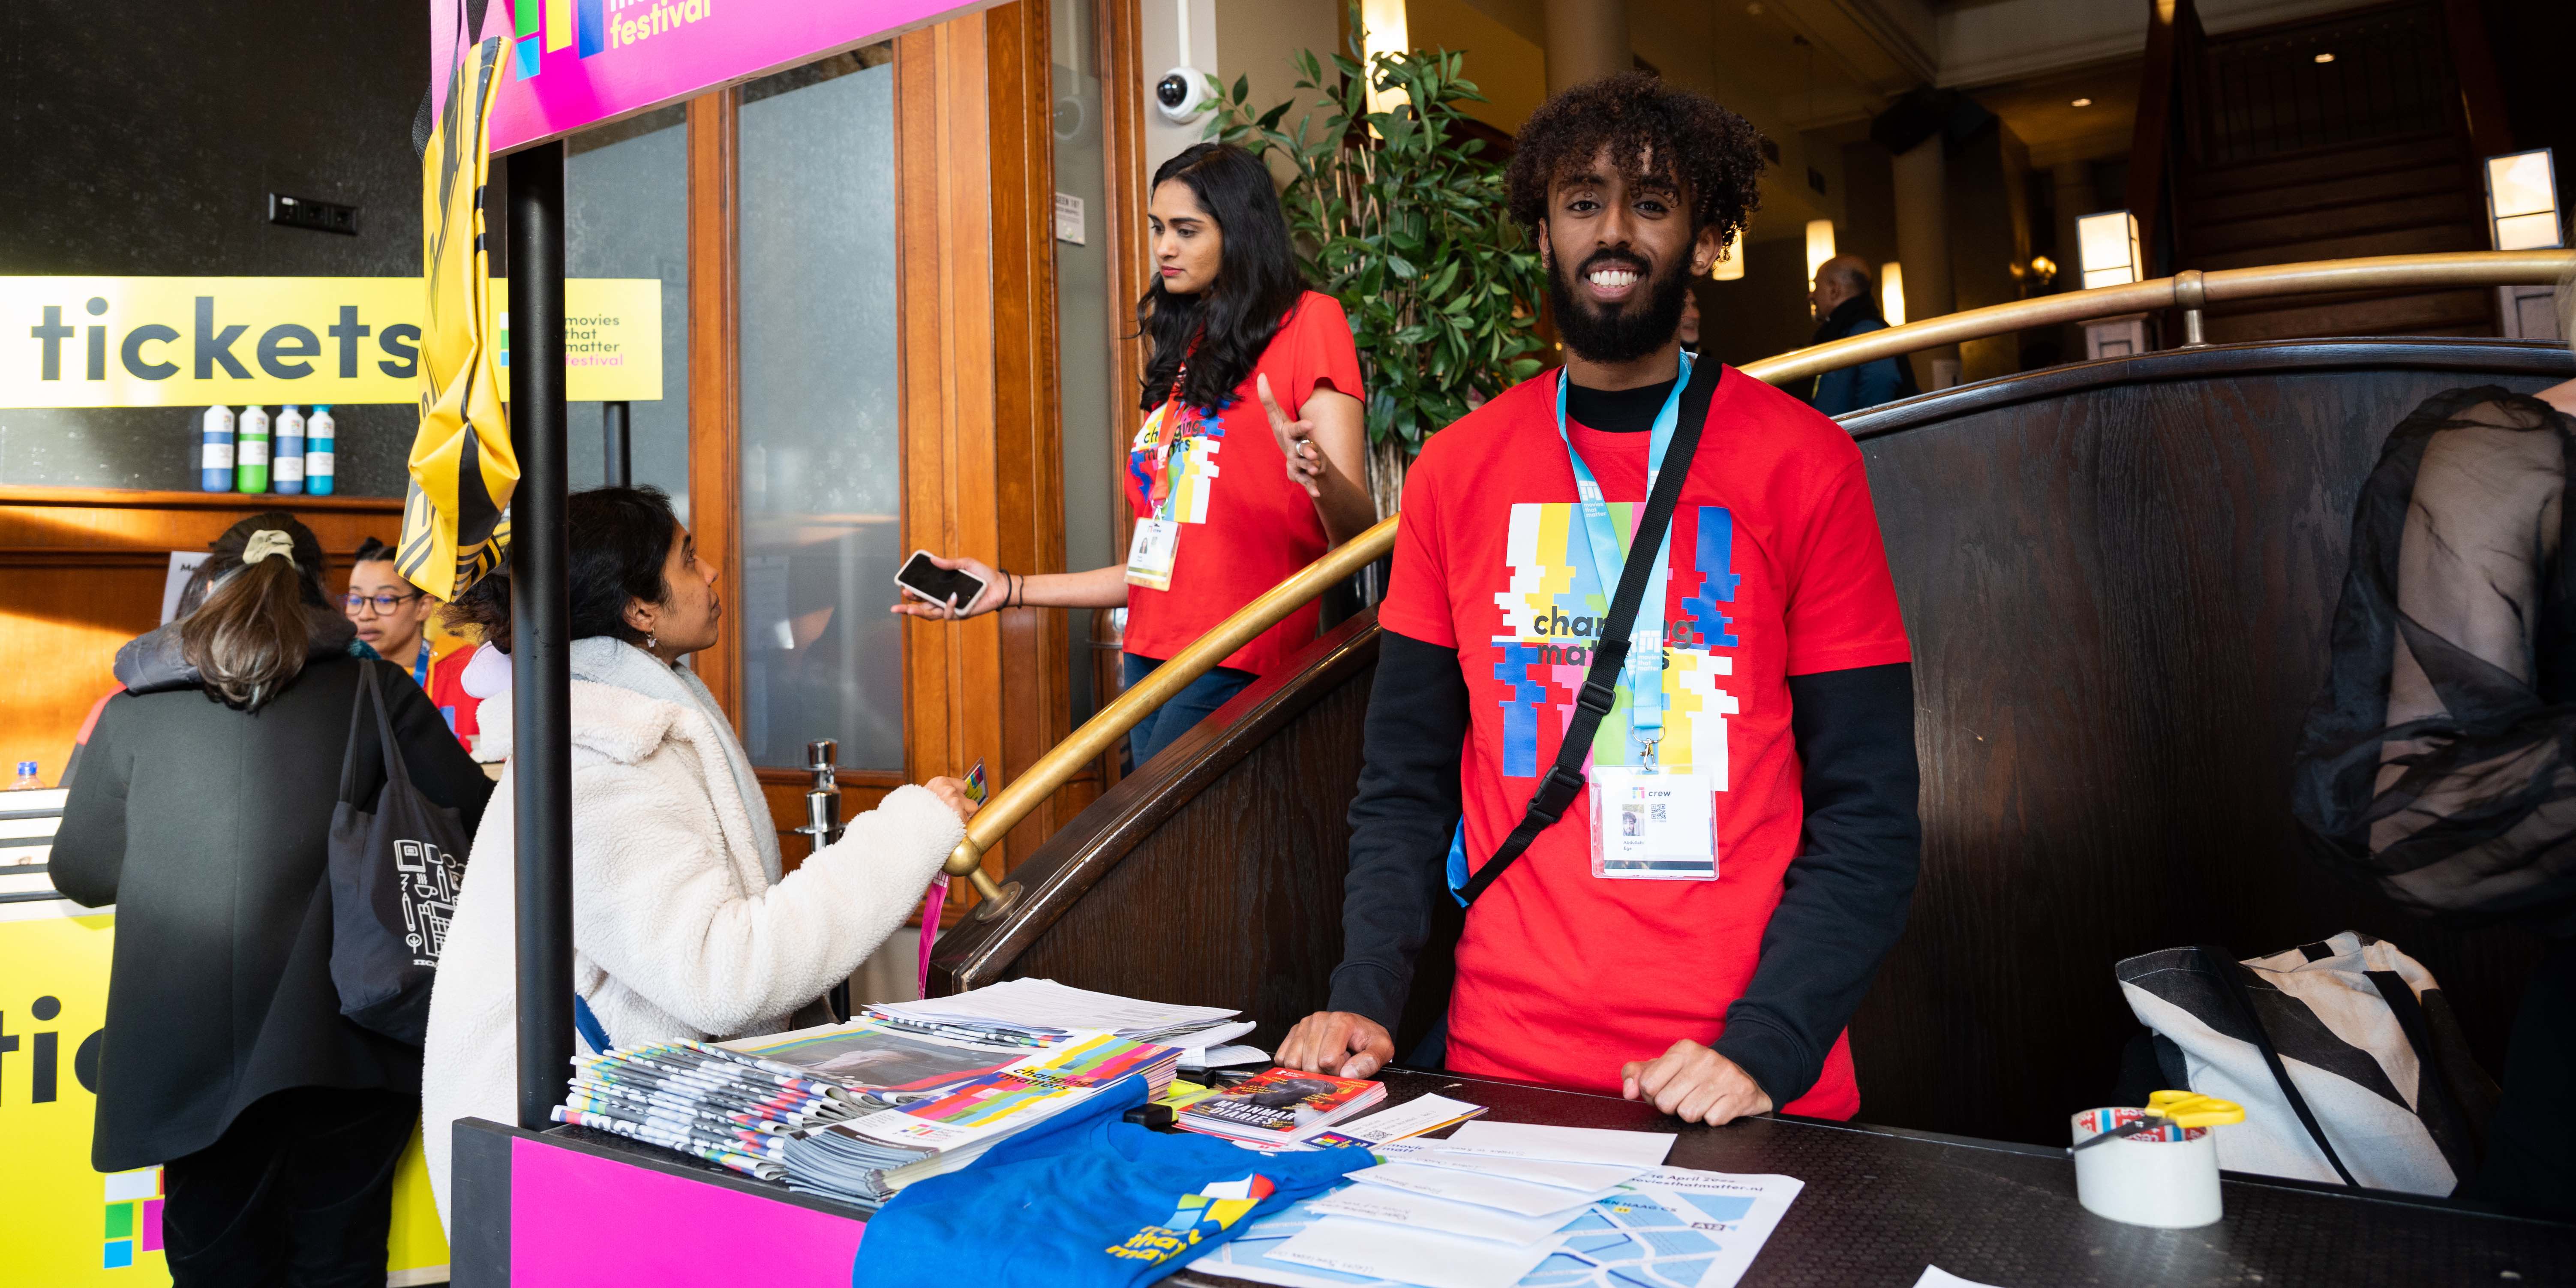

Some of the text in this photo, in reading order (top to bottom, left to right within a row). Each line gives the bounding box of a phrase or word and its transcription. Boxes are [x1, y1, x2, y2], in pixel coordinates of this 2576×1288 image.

[610, 0, 710, 49] festival
[565, 313, 619, 326] movies
[31, 296, 421, 380] tickets
[565, 328, 597, 339] that
[565, 341, 620, 352] matter
[565, 354, 624, 366] festival
[1000, 1073, 1069, 1090] matters
[1209, 1107, 1278, 1125] DIARIES
[1213, 1100, 1297, 1120] MYANMAR
